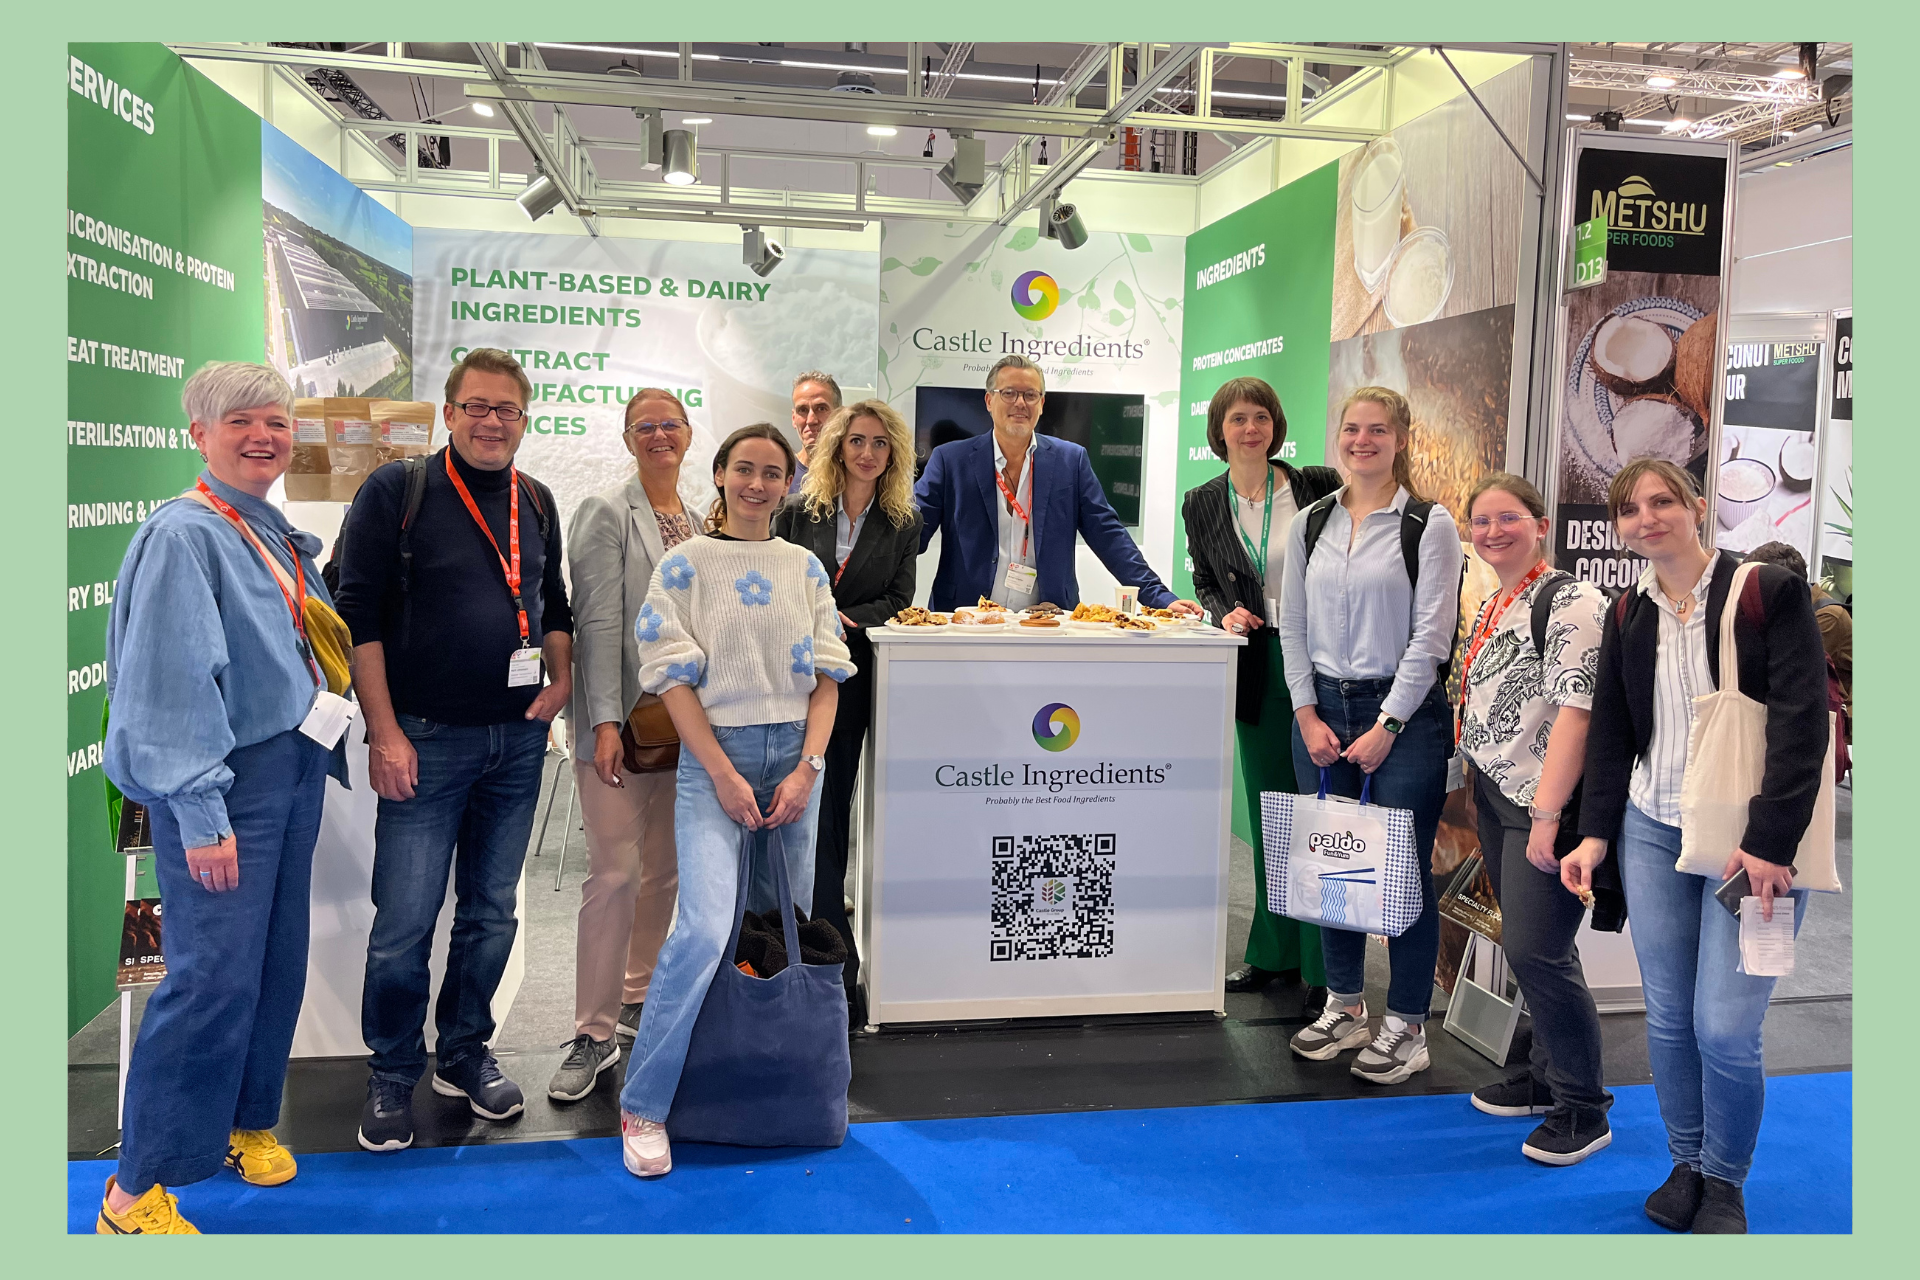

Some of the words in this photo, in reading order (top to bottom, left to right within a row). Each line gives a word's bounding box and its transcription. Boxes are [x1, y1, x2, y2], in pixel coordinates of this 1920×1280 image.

[1590, 189, 1707, 232] METSHU
[1576, 222, 1592, 241] 1.2
[1607, 231, 1629, 245] PER
[1632, 233, 1675, 248] FOODS
[67, 208, 172, 269] ICRONISATION
[175, 251, 184, 274] &
[187, 255, 234, 292] PROTEIN
[1197, 243, 1265, 290] INGREDIENTS
[1576, 256, 1603, 283] D13
[451, 267, 652, 296] PLANT-BASED
[659, 277, 679, 298] &
[687, 279, 771, 302] DAIRY
[451, 300, 641, 328] INGREDIENTS
[912, 327, 992, 353] Castle
[1774, 342, 1817, 359] METSHU
[1837, 336, 1853, 365] C
[101, 343, 184, 379] TREATMENT
[450, 346, 611, 371] CTRACT
[1193, 351, 1223, 371] PROTEIN
[1224, 336, 1284, 364] CONCENTATES
[1773, 358, 1788, 366] SUPER
[1789, 356, 1805, 364] FOODS
[1050, 366, 1094, 377] Ingredients
[168, 427, 179, 449] &
[136, 500, 146, 522] &
[935, 764, 1014, 787] Castle
[985, 796, 1020, 806] Probably
[1021, 796, 1034, 804] the
[1035, 796, 1052, 804] Best
[1053, 795, 1072, 803] Food
[1072, 794, 1116, 804] Ingredients
[1309, 831, 1366, 852] paldo
[1457, 893, 1489, 914] SPECIALTY
